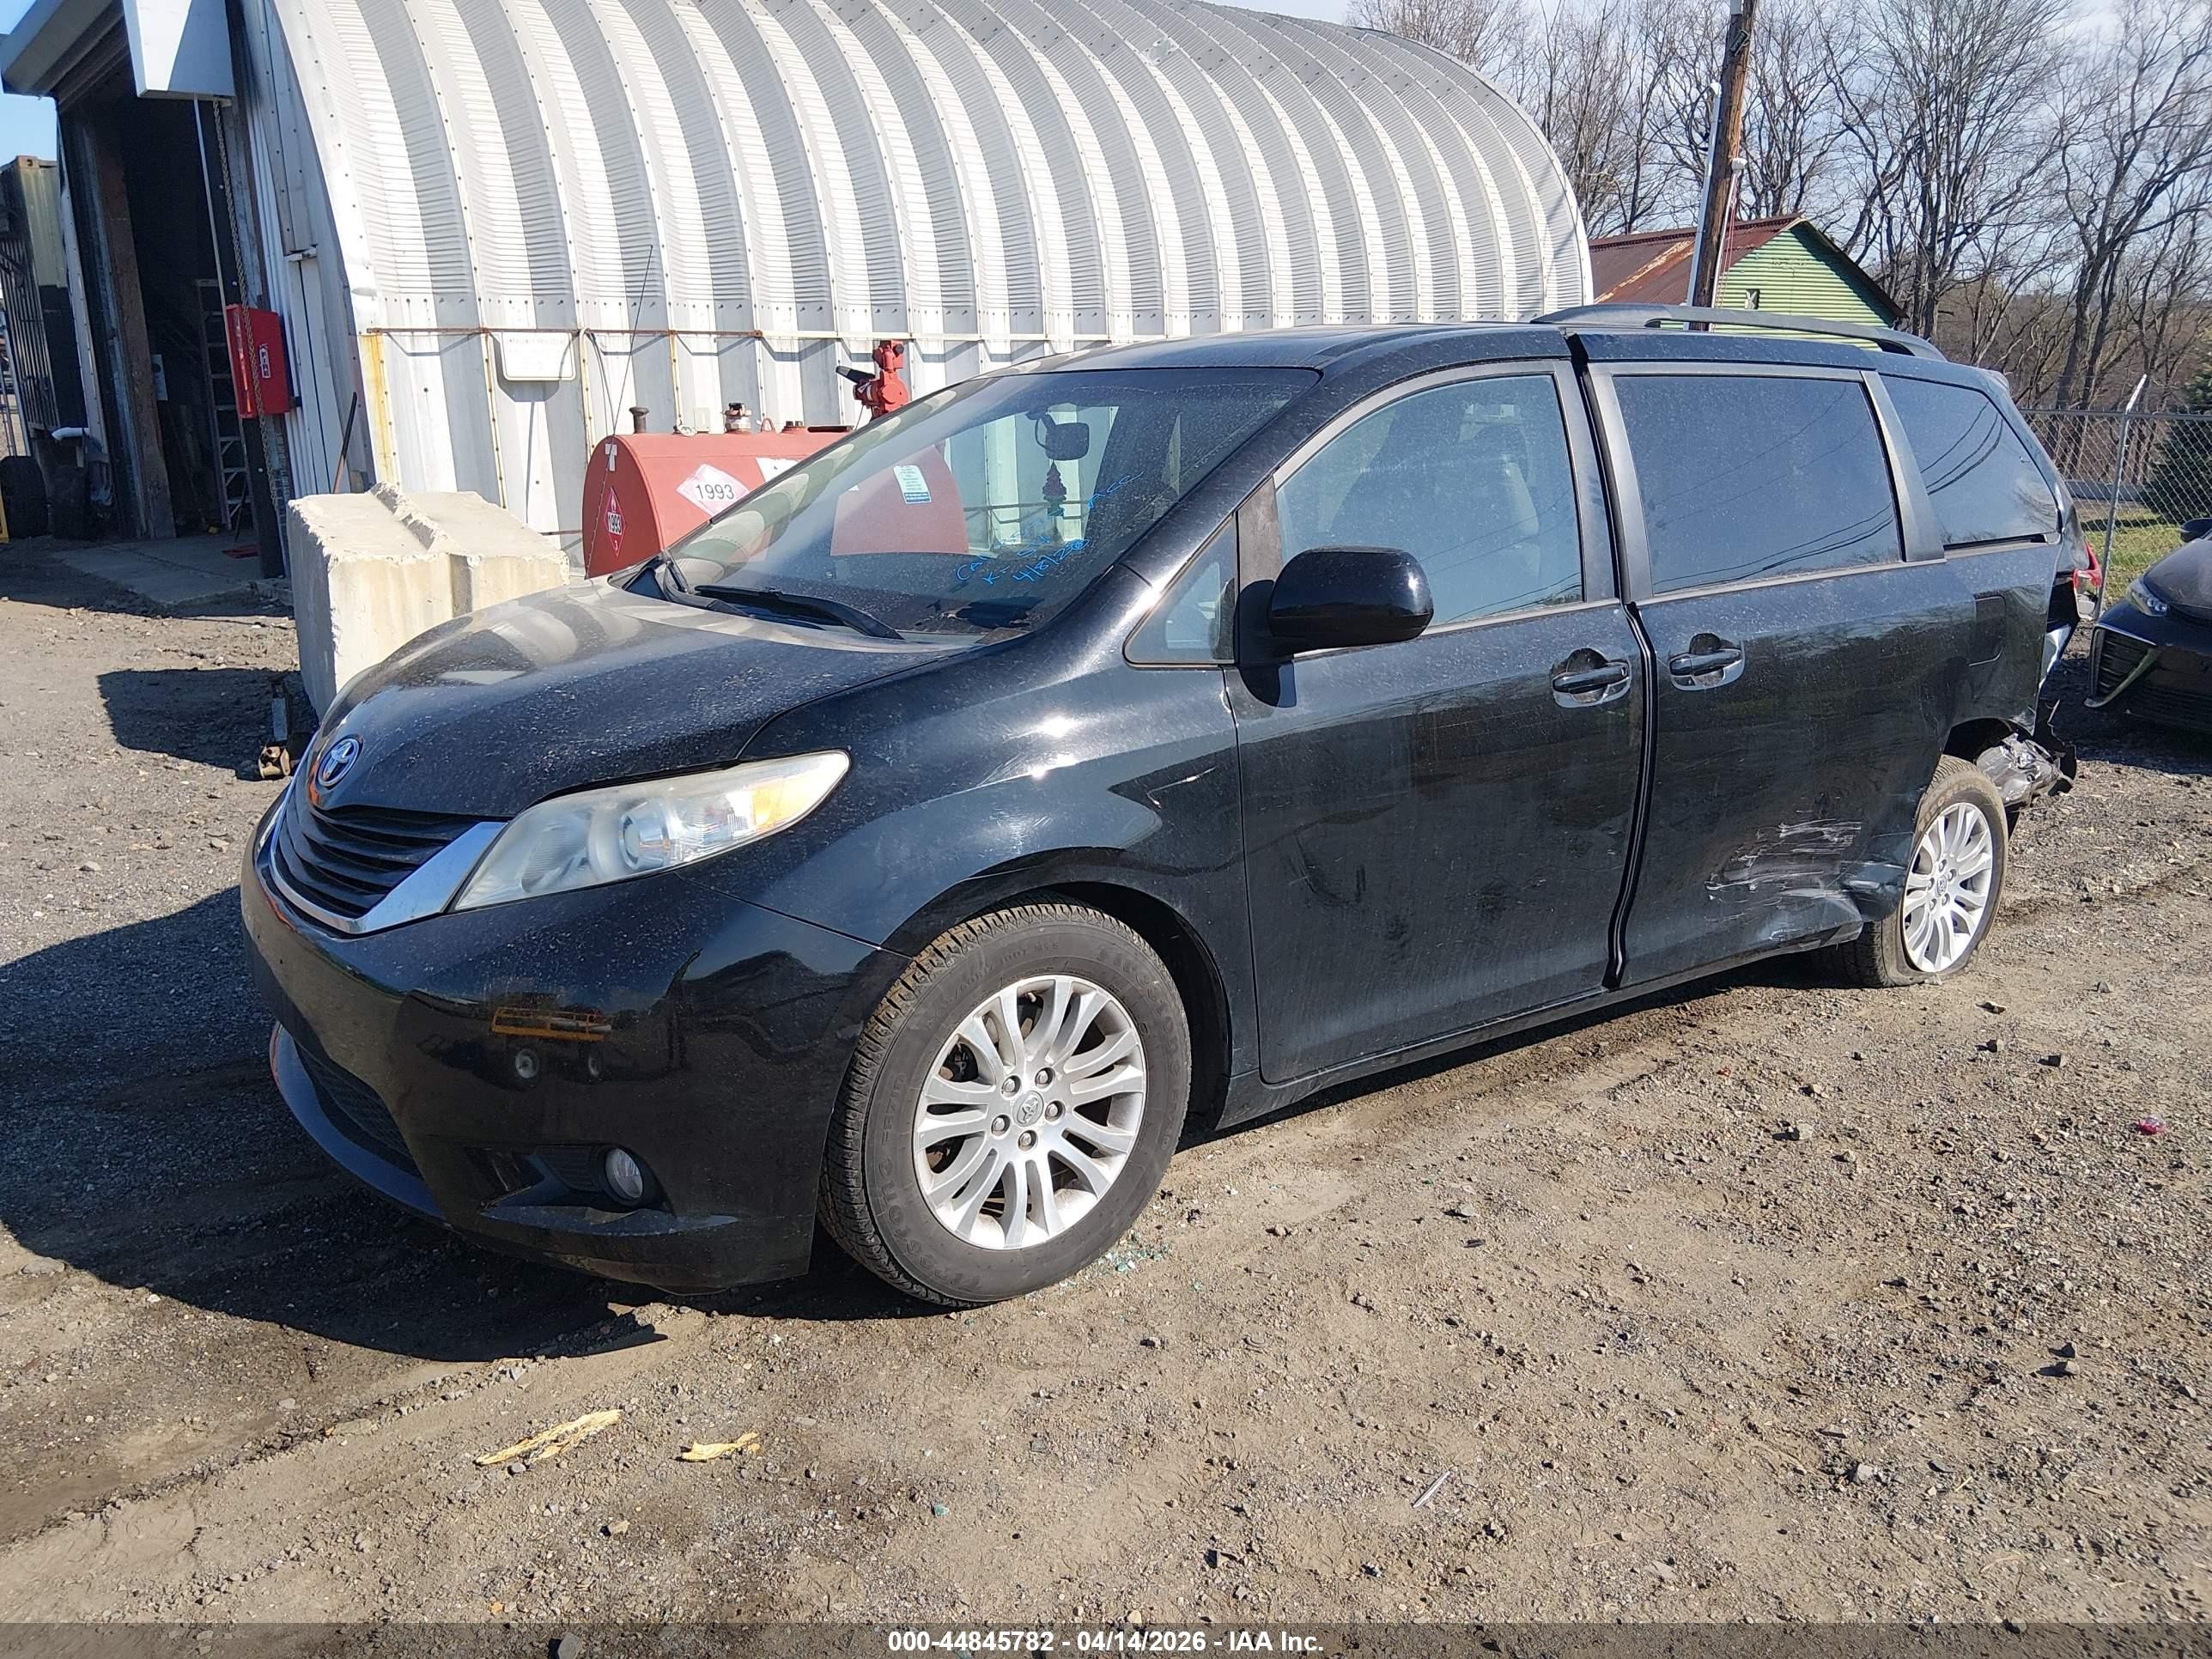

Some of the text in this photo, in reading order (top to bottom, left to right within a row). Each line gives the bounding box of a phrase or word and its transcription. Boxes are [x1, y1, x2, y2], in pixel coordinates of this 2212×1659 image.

[696, 483, 734, 500] 1993
[608, 515, 621, 534] 1993
[613, 539, 619, 551] 3
